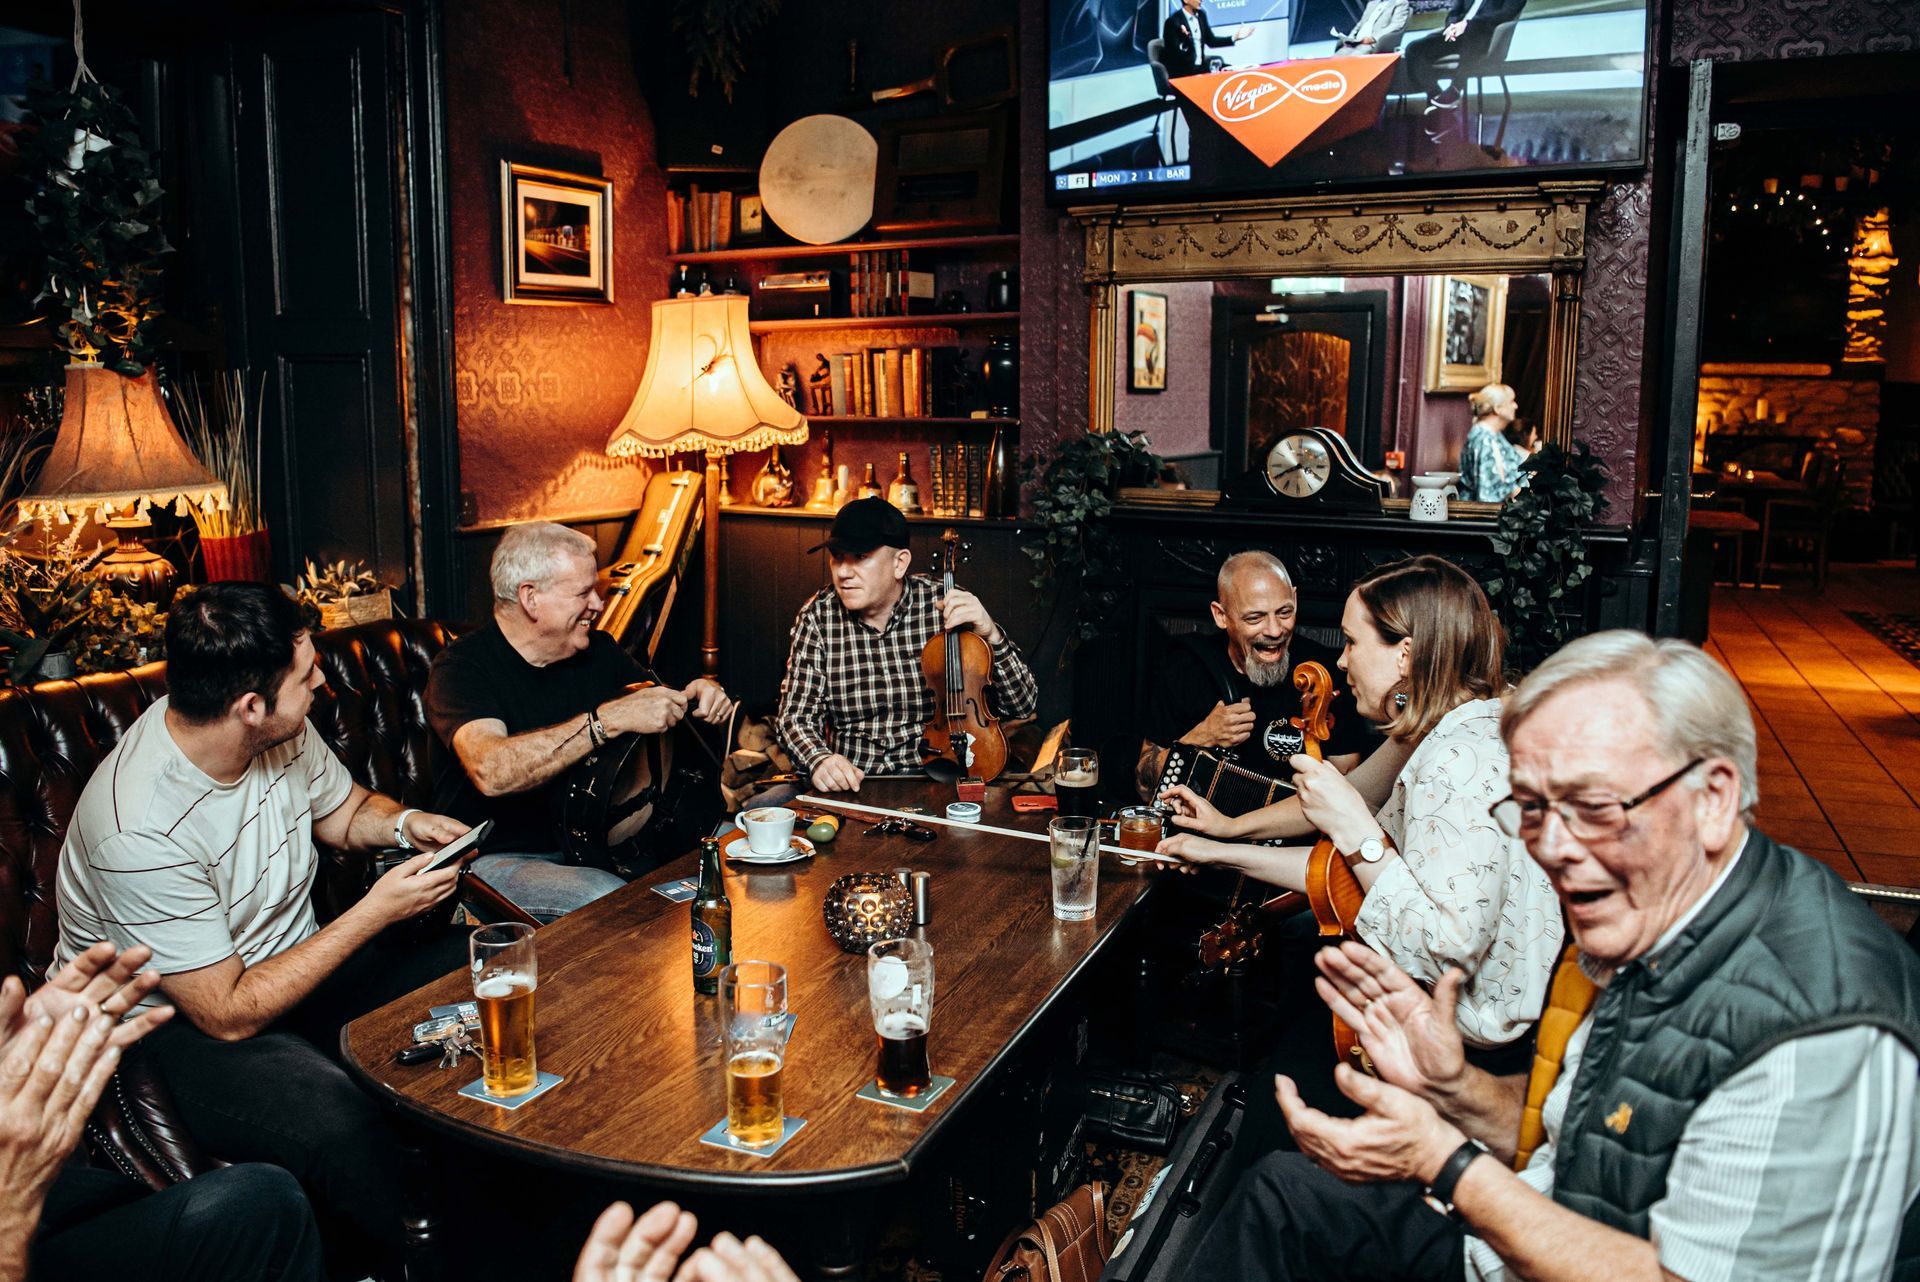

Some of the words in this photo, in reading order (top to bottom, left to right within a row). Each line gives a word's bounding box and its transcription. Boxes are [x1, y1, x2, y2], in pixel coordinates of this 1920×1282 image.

[1216, 0, 1247, 9] LEAGUE
[1223, 79, 1278, 111] Virgin
[1301, 80, 1341, 92] media
[1076, 177, 1086, 186] FT
[1100, 173, 1121, 184] MON
[1131, 172, 1138, 182] 2
[1148, 171, 1154, 181] 1
[1166, 168, 1186, 179] BAR
